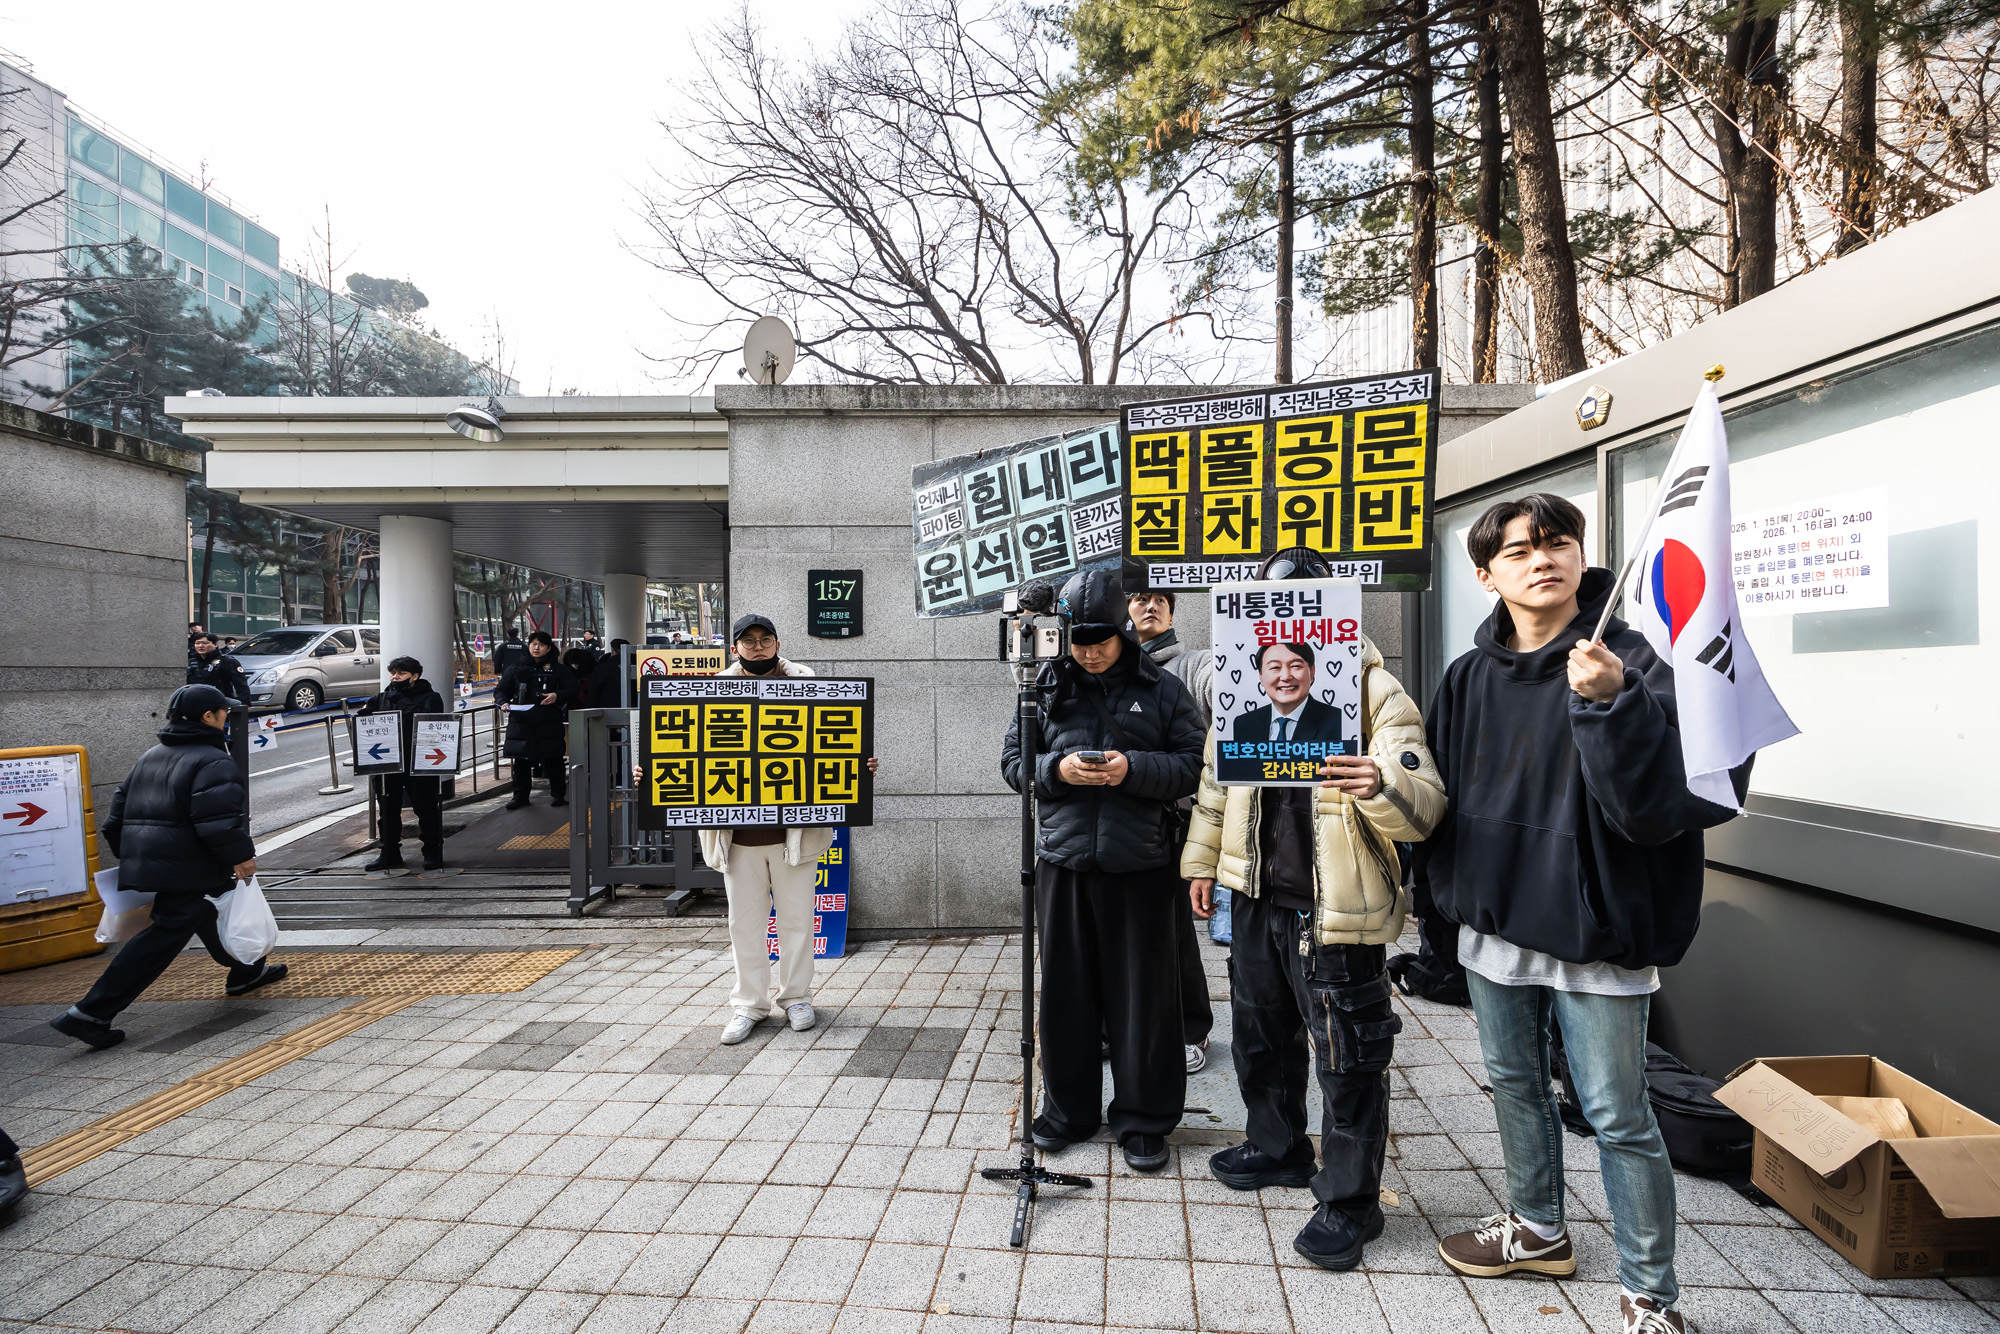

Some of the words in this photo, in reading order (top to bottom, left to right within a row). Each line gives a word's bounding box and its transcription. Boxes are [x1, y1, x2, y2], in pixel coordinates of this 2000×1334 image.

[1129, 397, 1263, 426] 특수공무집행방해
[968, 431, 1119, 525] 힘내라
[918, 482, 960, 511] 언제나
[922, 510, 963, 537] 파이팅
[1731, 523, 1748, 533] 026.
[1763, 527, 1787, 538] 2026.
[1843, 511, 1872, 525] 24:00
[1850, 533, 1861, 544] 외
[923, 515, 1071, 605] 윤석열
[814, 580, 856, 601] 157
[1734, 580, 1745, 590] 원
[1775, 575, 1784, 585] 시
[1745, 590, 1794, 603] 이용하시기
[1801, 585, 1848, 597] 바랍니다.
[1216, 589, 1322, 619] 대통령님
[1253, 618, 1358, 646] 힘내세요
[672, 657, 721, 669] 오토바이
[650, 681, 758, 696] 특수공무집행방해
[360, 717, 375, 725] 법원
[1262, 762, 1347, 779] 감사합니
[667, 807, 777, 823] 무단침입저지는
[784, 806, 844, 823] 정당방위
